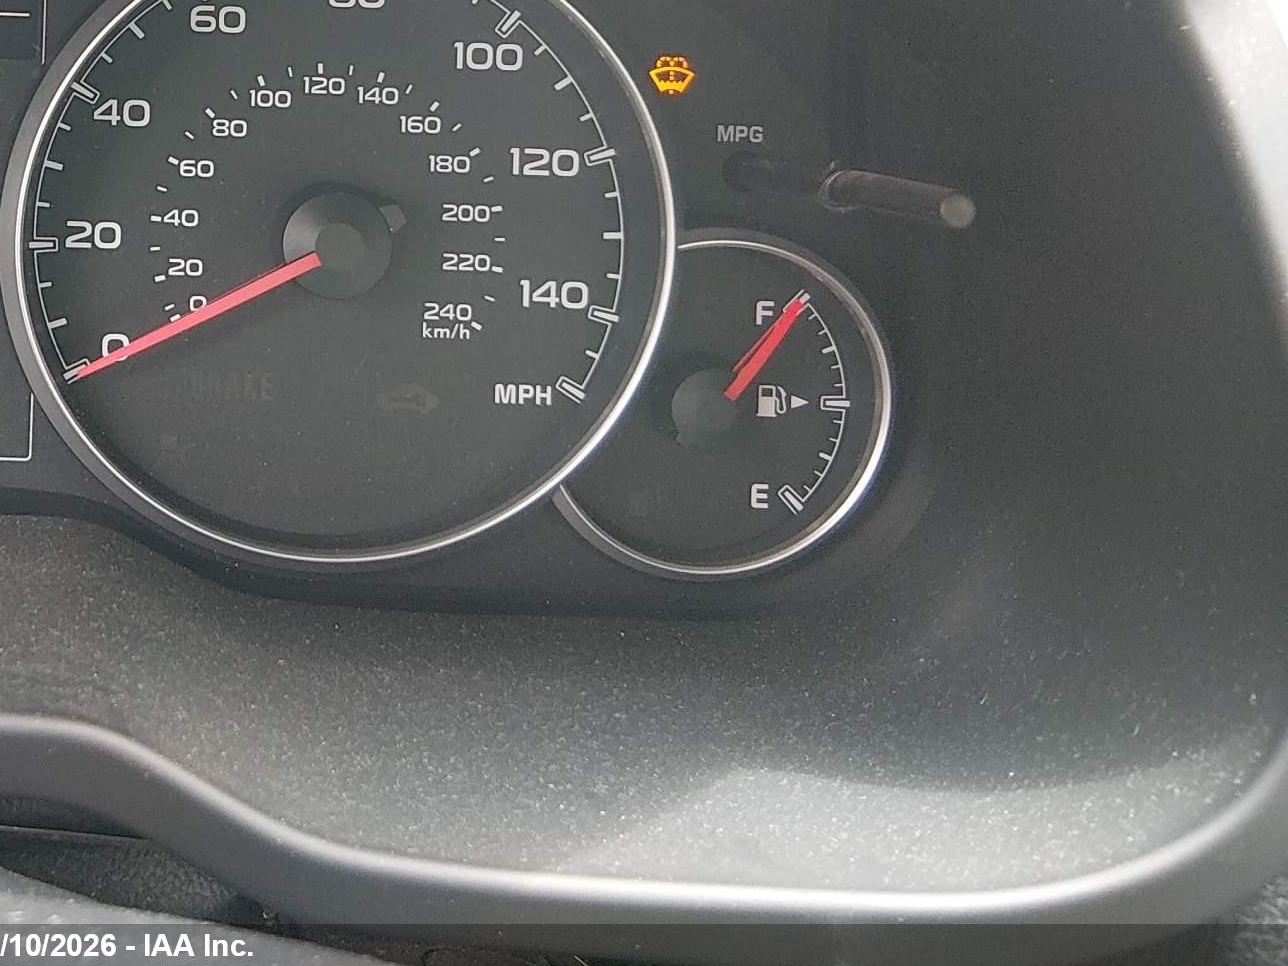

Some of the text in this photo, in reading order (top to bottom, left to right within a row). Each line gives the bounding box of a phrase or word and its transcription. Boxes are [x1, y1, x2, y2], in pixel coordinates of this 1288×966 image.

[191, 6, 245, 33] 60
[454, 42, 522, 70] 100
[304, 77, 345, 94] 120
[250, 90, 291, 107] 100
[358, 87, 398, 104] 140
[94, 100, 150, 126] 40
[212, 120, 247, 137] 80
[400, 116, 441, 133] 160
[718, 125, 763, 142] MPG
[180, 160, 214, 177] 60
[429, 156, 469, 173] 180
[511, 148, 579, 176] 120
[164, 210, 198, 226] 40
[443, 205, 489, 222] 200
[66, 221, 121, 248] 20
[169, 259, 202, 275] 20
[443, 254, 490, 271] 220
[520, 281, 588, 309] 140
[190, 296, 207, 312] 0
[424, 303, 471, 320] 240
[756, 301, 774, 324] F
[423, 322, 469, 339] km/h
[102, 334, 130, 361] 0
[495, 384, 551, 405] MPH
[751, 484, 768, 508] E
